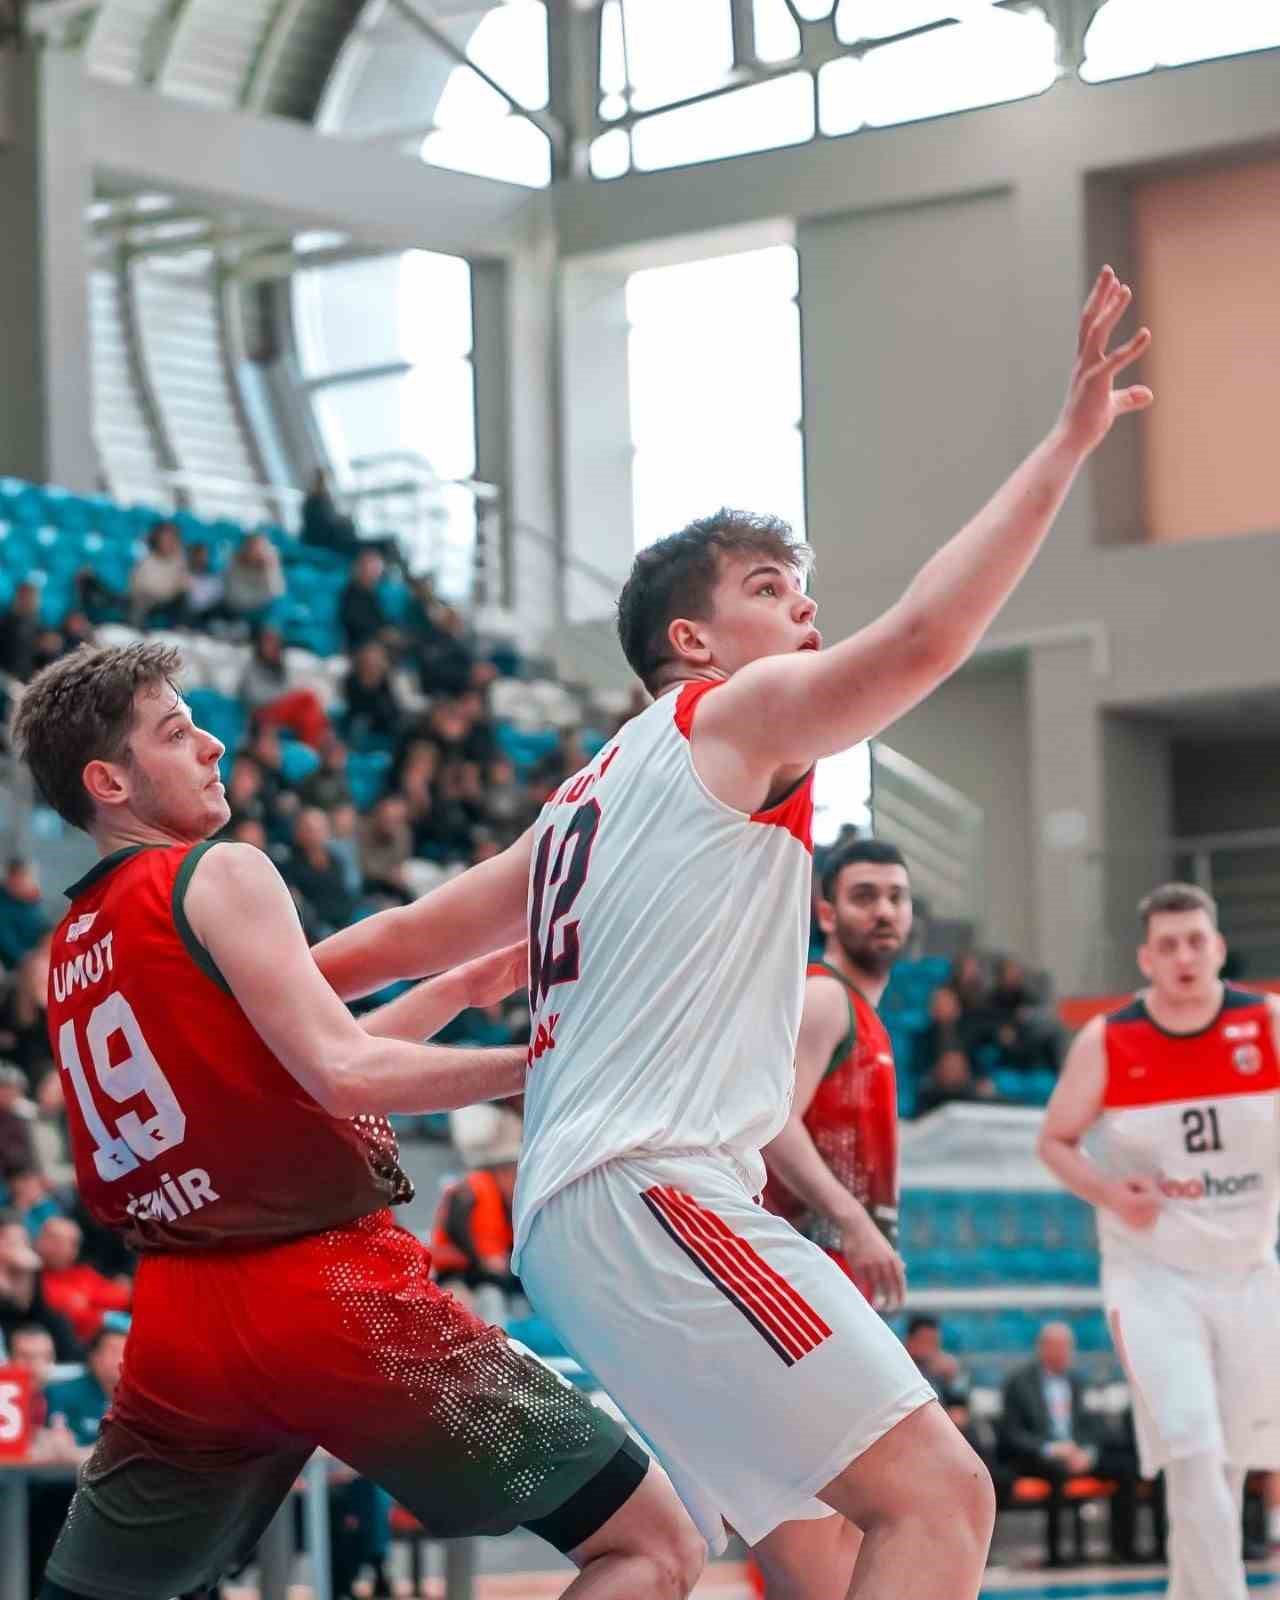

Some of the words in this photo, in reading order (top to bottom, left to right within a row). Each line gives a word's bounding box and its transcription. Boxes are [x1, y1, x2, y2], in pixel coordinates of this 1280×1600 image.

[53, 930, 113, 1002] UMUT
[527, 796, 601, 1016] 12
[59, 990, 187, 1183] 19
[1181, 1105, 1223, 1154] 21
